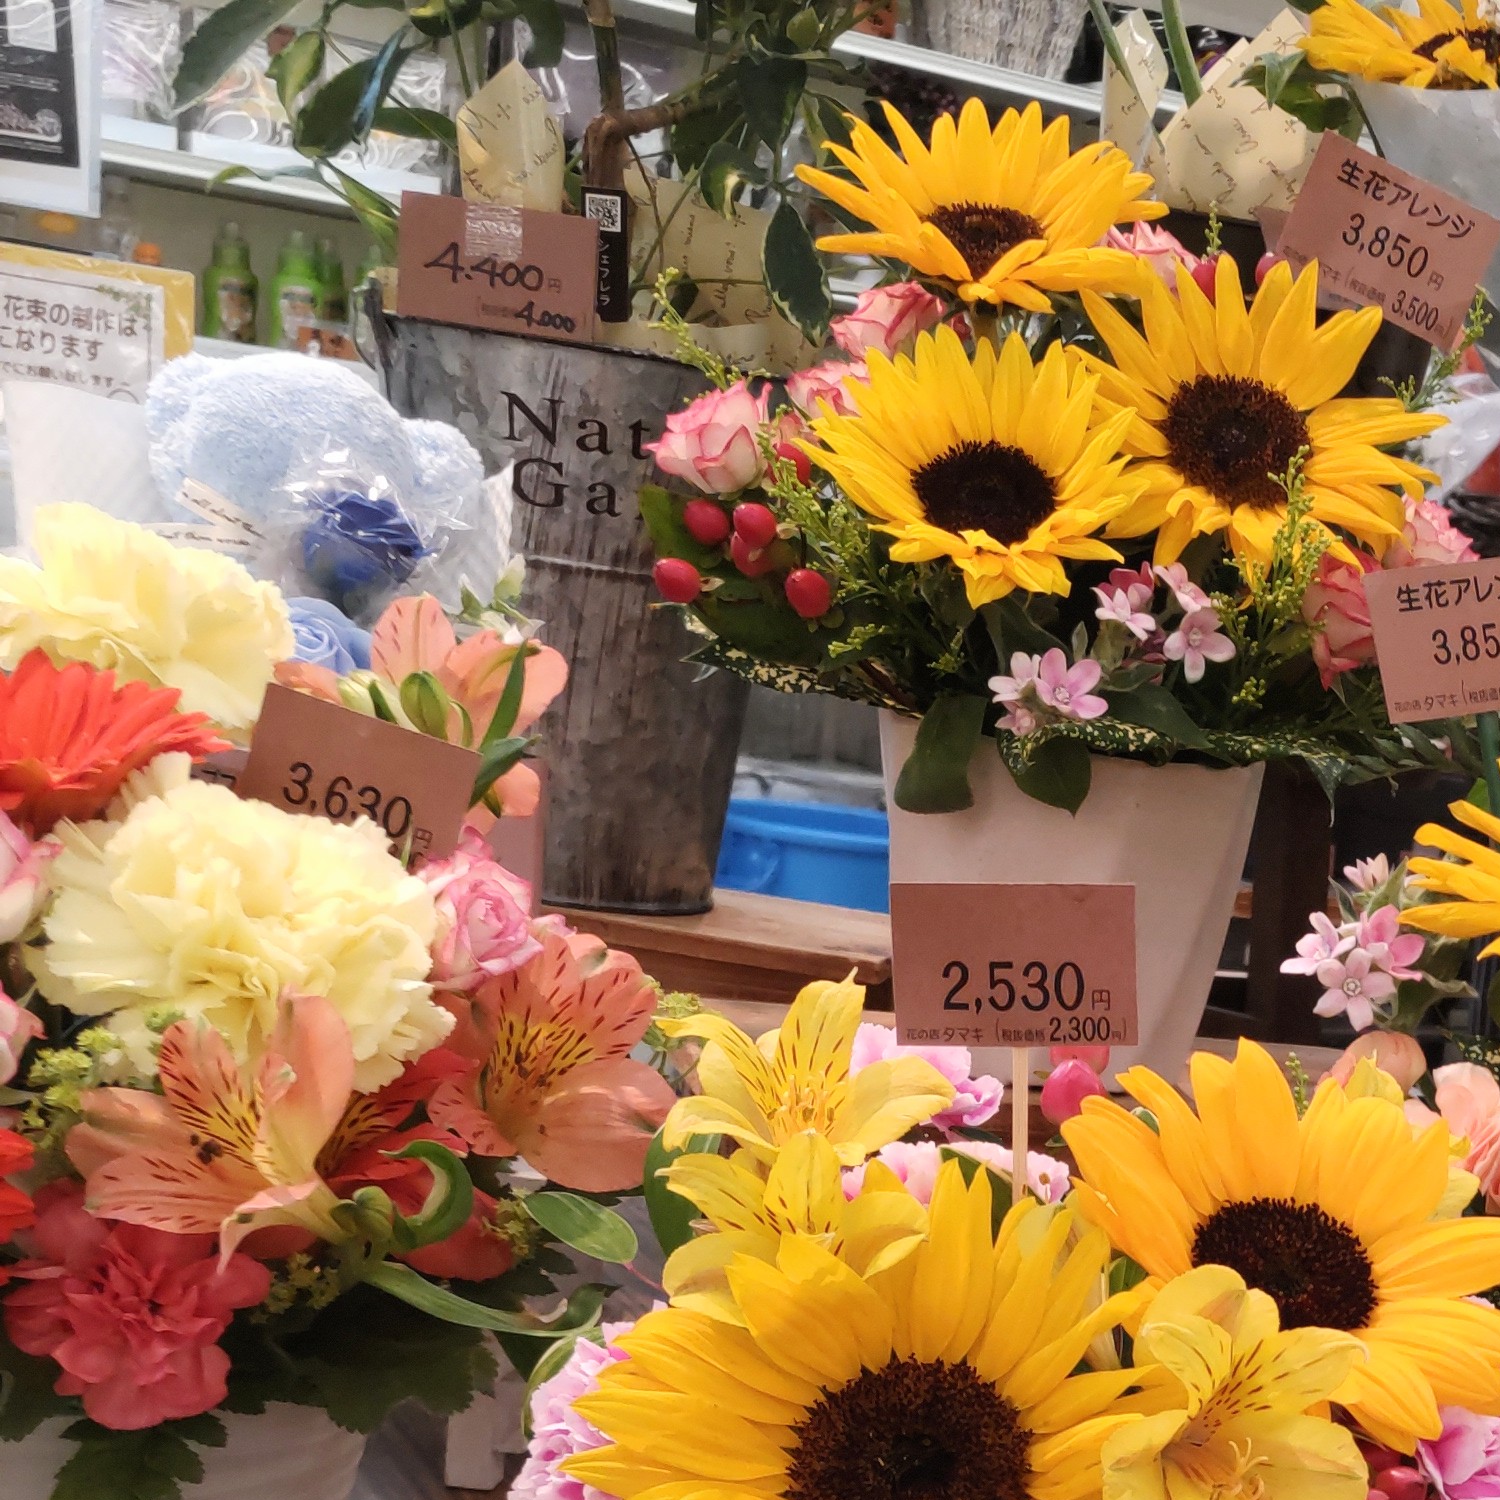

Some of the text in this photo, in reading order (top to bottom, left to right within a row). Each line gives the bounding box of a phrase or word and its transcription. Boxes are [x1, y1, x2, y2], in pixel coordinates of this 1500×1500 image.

[1336, 157, 1476, 239] 生花アレンジ
[512, 456, 645, 521] Ga
